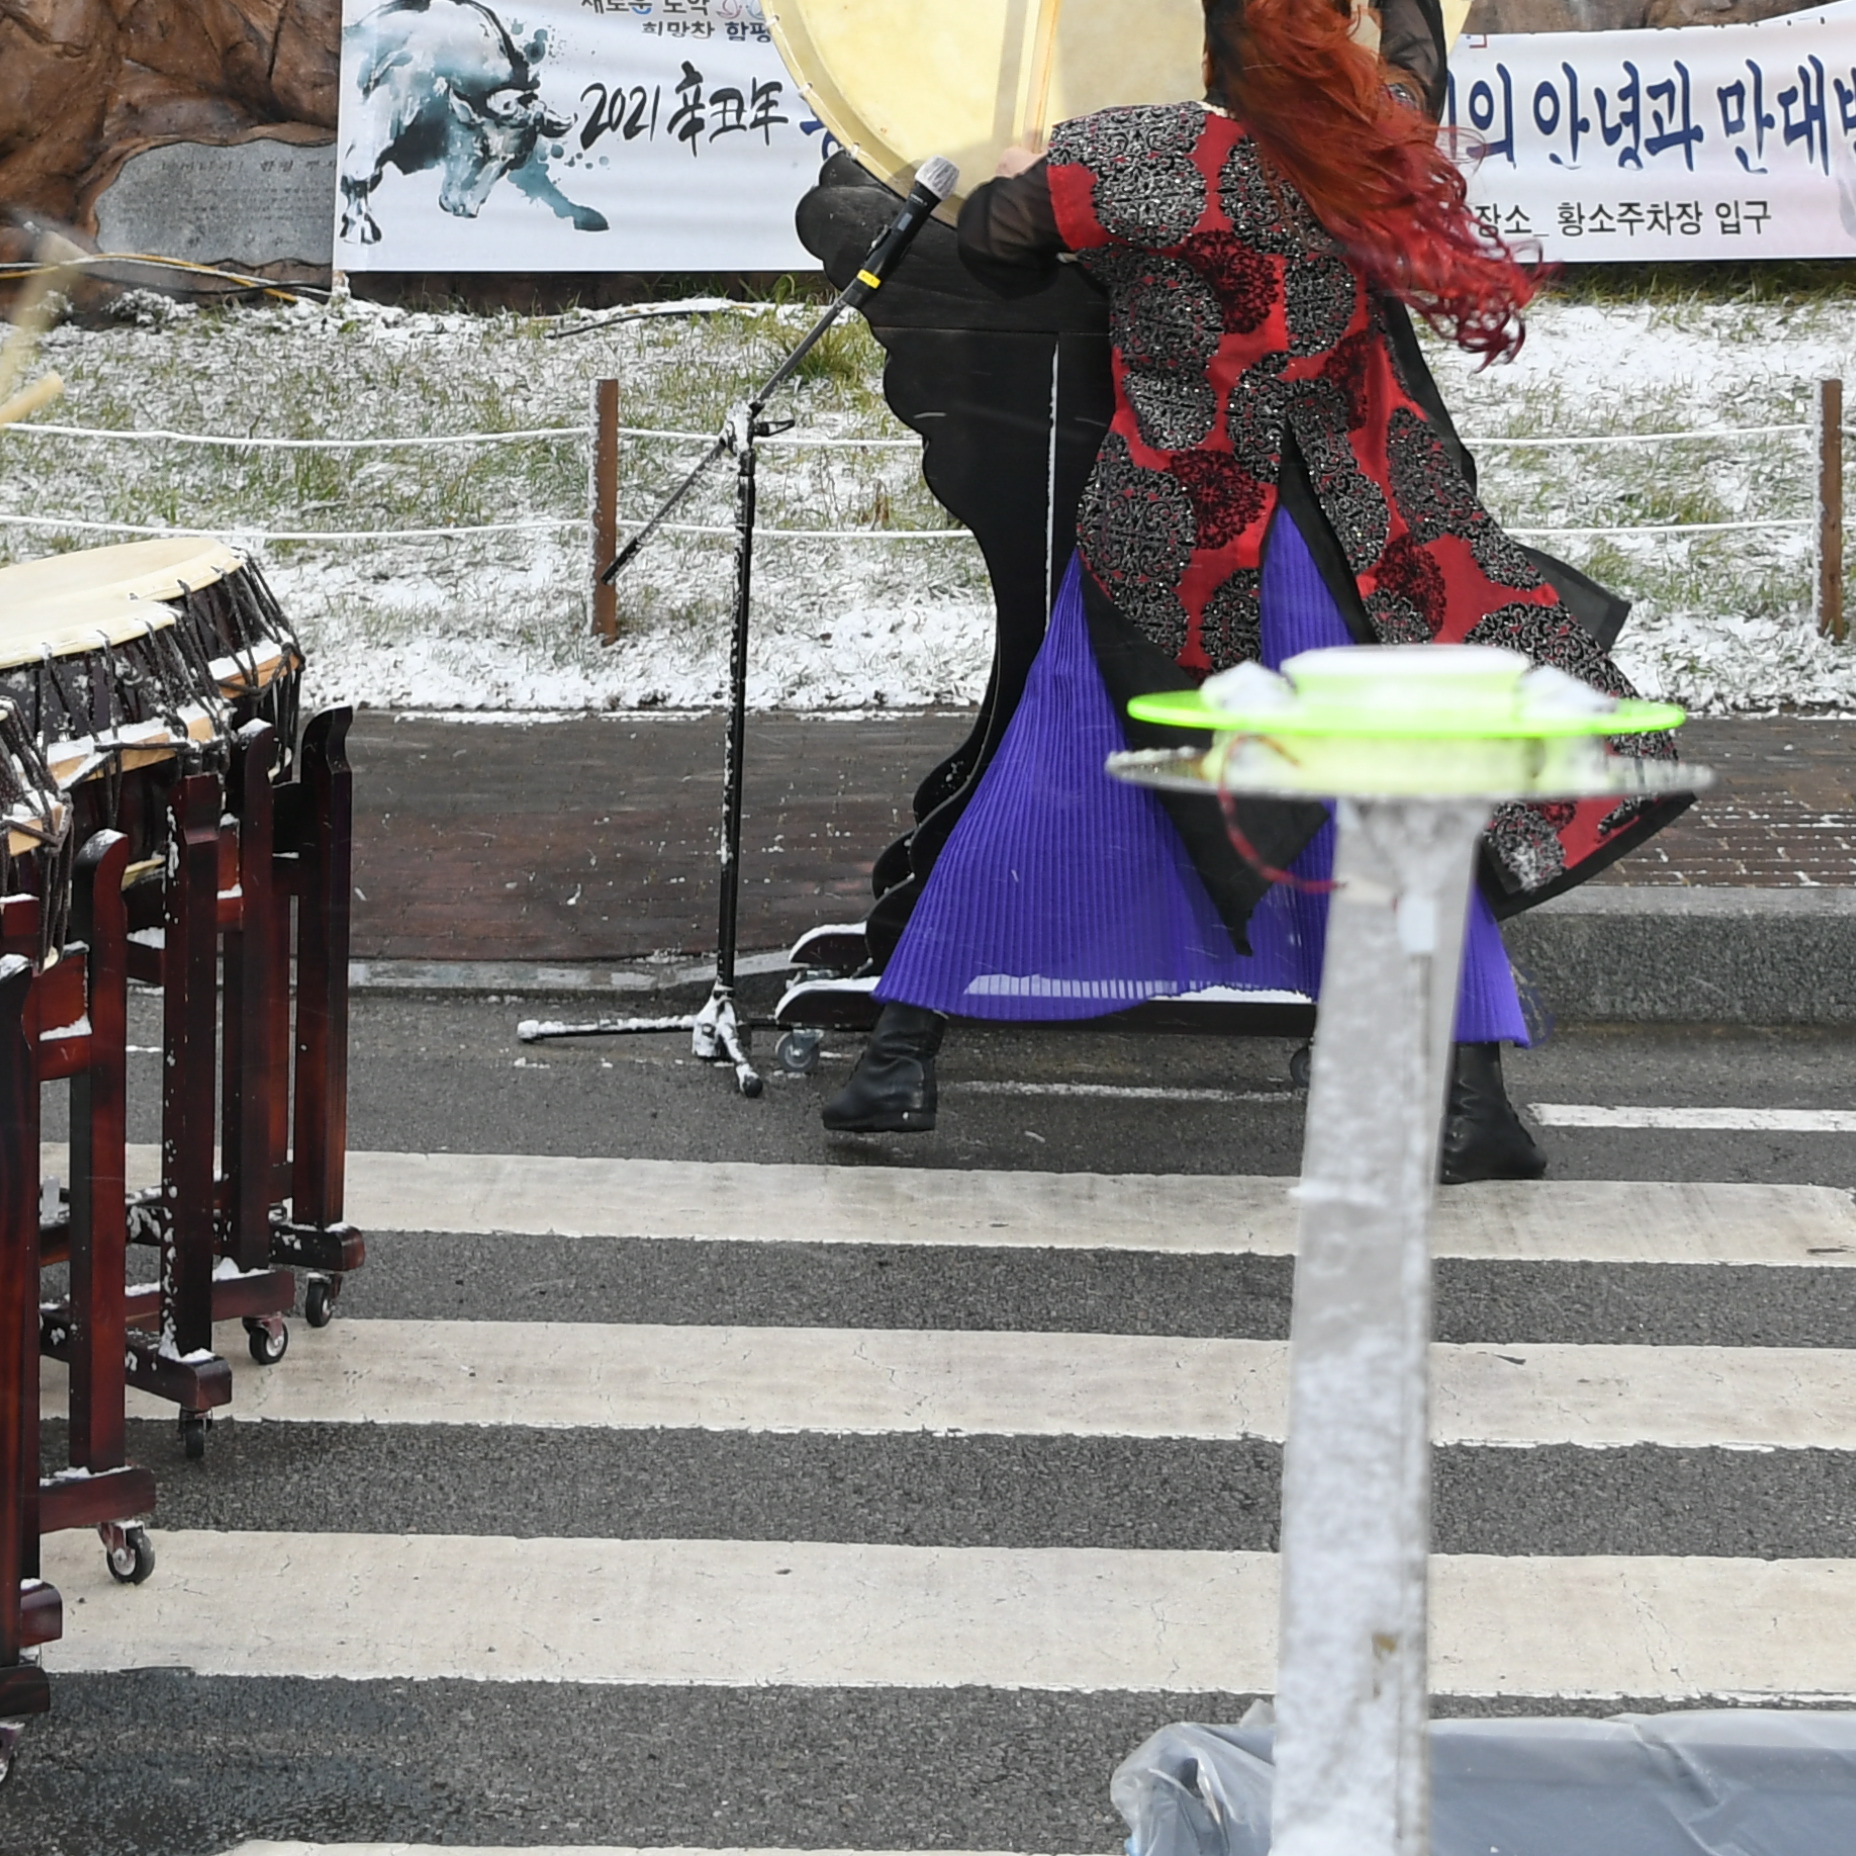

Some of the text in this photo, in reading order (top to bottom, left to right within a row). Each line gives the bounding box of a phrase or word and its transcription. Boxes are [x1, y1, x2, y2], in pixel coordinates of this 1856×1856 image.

[642, 20, 716, 39] 희망찬
[580, 82, 661, 150] 2021
[667, 60, 789, 158] 辛丑年
[1447, 62, 1516, 169] 의
[1533, 60, 1703, 172] 안녕과
[1557, 200, 1703, 237] 황소주차장
[1715, 199, 1772, 235] 입구
